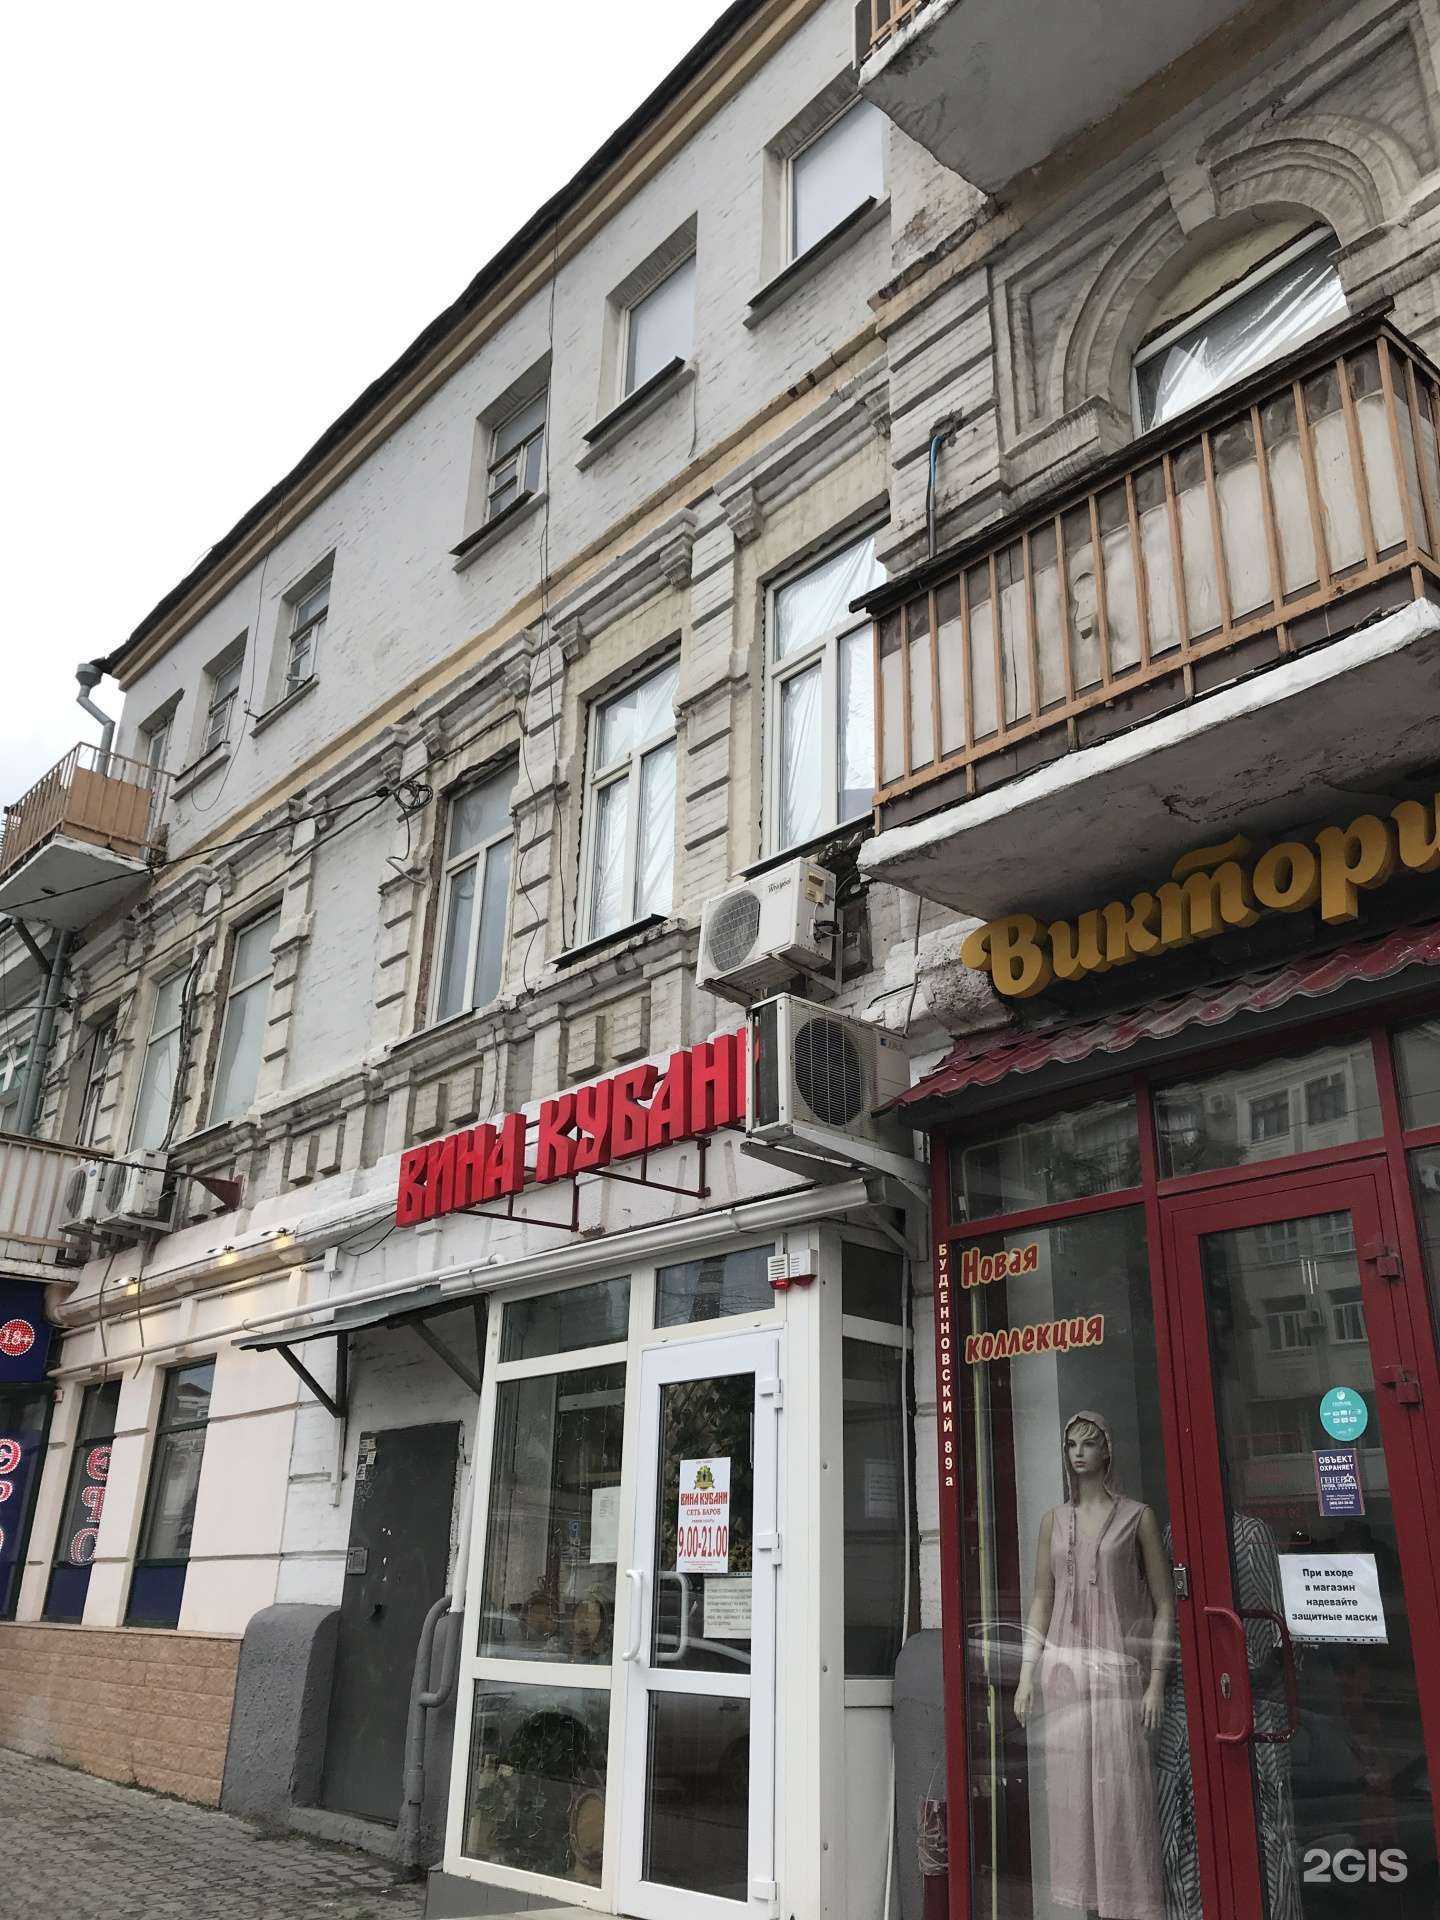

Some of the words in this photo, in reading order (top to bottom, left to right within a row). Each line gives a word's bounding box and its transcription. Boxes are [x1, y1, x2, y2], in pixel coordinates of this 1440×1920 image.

[396, 1113, 526, 1228] ВИНА
[961, 1243, 1039, 1288] Новая
[938, 1243, 953, 1433] БУДЕННОВСКИЙ
[965, 1314, 1104, 1364] коллекция
[1318, 1455, 1353, 1464] ОБЪЕКТ
[1319, 1464, 1354, 1472] ОХРАНЯЕТ
[681, 1493, 699, 1506] ВИНА
[700, 1491, 728, 1505] КУБАНИ
[679, 1525, 728, 1558] 9.00-21.00
[1302, 1568, 1321, 1579] При
[1324, 1569, 1354, 1578] входе
[1313, 1584, 1356, 1592] магазин
[1306, 1597, 1358, 1607] надевайте
[1292, 1613, 1342, 1622] защитные
[1345, 1614, 1378, 1622] маски
